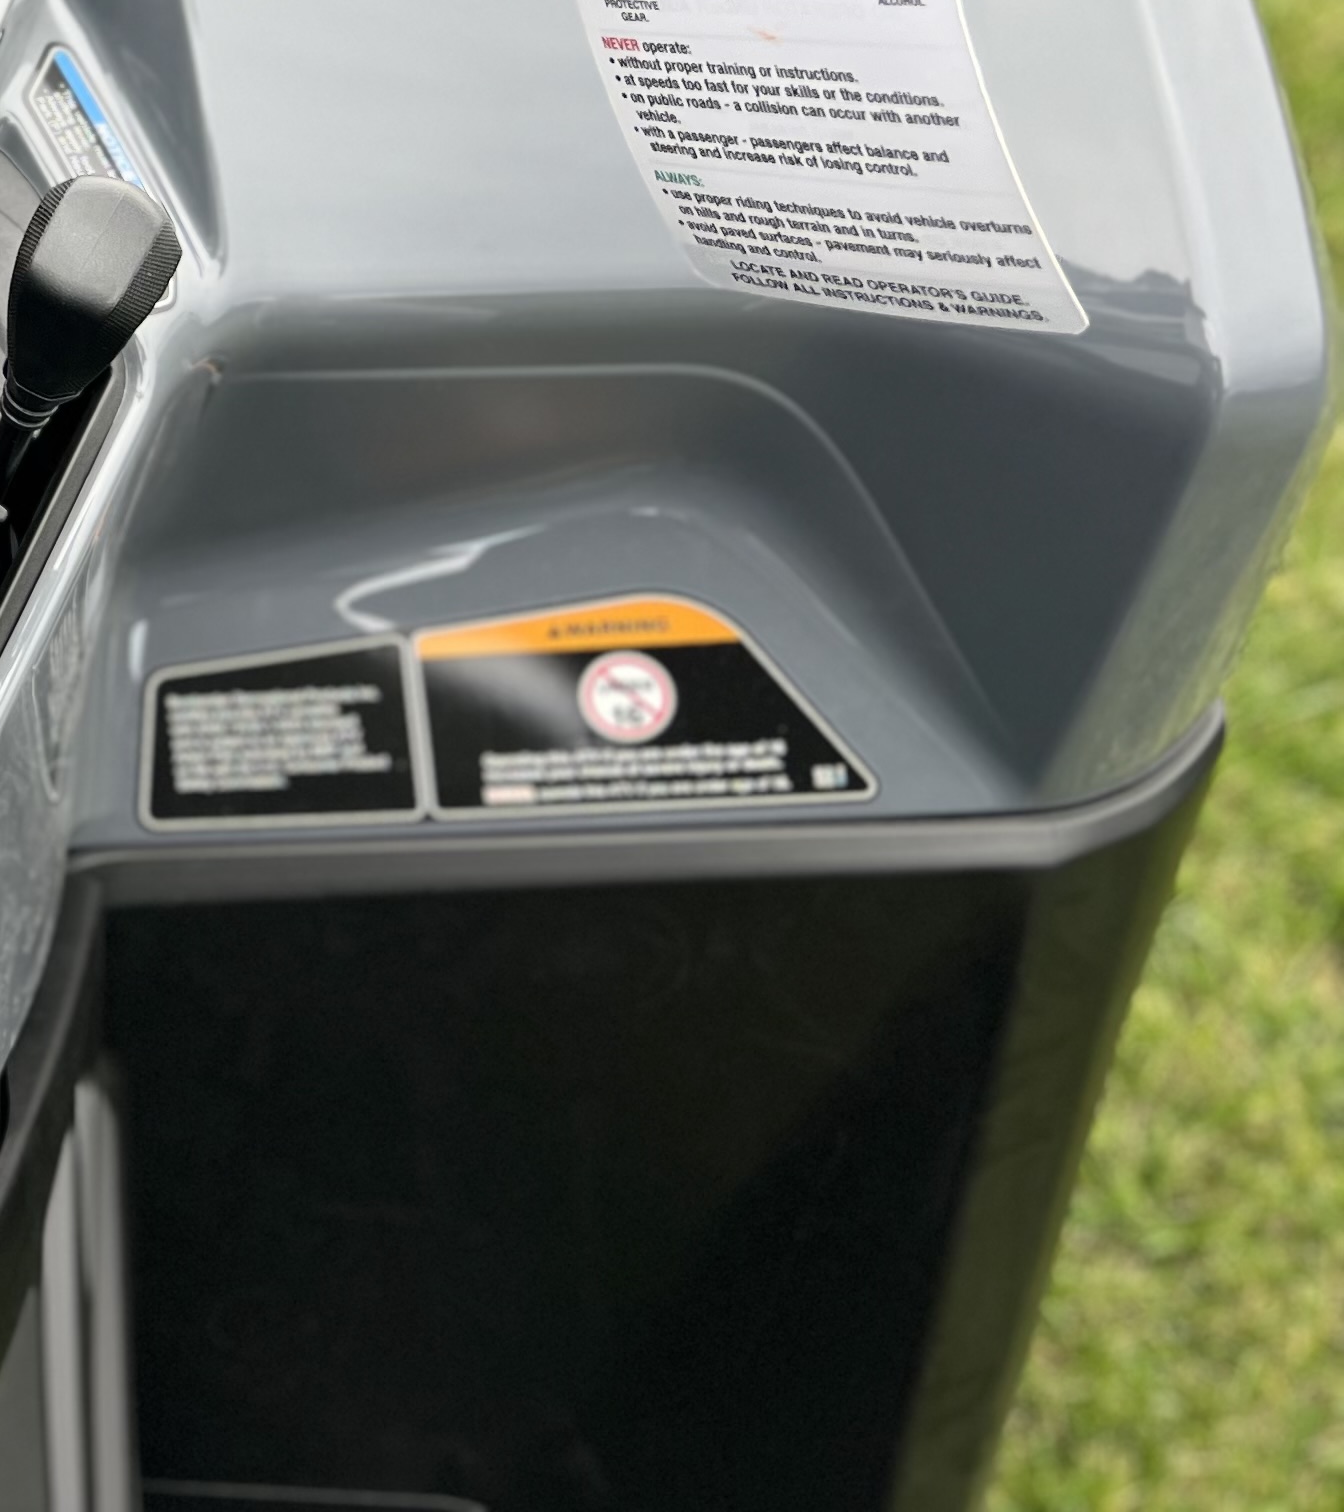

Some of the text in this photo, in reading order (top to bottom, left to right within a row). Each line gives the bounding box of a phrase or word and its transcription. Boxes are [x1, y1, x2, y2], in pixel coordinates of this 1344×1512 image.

[605, 0, 659, 10] PROTECTIVE
[602, 37, 692, 54] NEVER operate:
[618, 56, 859, 83] without proper training or instructions.
[624, 75, 944, 107] at speeds too fast for your skills or the conditions.
[630, 93, 645, 103] on
[647, 94, 684, 107] public
[687, 97, 721, 110] roads
[734, 102, 742, 111] a
[745, 101, 798, 116] collision
[801, 106, 826, 117] can
[830, 108, 866, 121] occur
[870, 109, 901, 123] with
[906, 113, 959, 126] another
[636, 110, 681, 124] vehicle.
[641, 126, 665, 139] with
[668, 130, 675, 139] a
[678, 130, 739, 148] passenger
[749, 136, 823, 153] passengers
[826, 141, 862, 155] affect
[865, 144, 919, 161] balance
[922, 150, 949, 163] and
[650, 141, 697, 159] steering
[700, 147, 722, 159] and
[724, 149, 776, 164] increase
[779, 153, 802, 166] risk
[806, 155, 818, 167] of
[821, 157, 862, 174] losing
[654, 170, 704, 186] ALWAYS:
[670, 189, 1032, 234] use proper riding techniques to avoid vehicle overturns
[679, 205, 694, 215] on
[694, 207, 721, 220] hills
[723, 211, 746, 223] and
[749, 215, 785, 229] rough
[786, 217, 830, 233] terrain
[834, 223, 859, 236] and
[863, 225, 875, 238] in
[687, 220, 718, 234] avoid
[720, 226, 756, 239] paved
[759, 231, 812, 246] surfaces
[825, 239, 891, 256] pavement
[893, 247, 923, 261] may
[926, 249, 992, 267] seriously
[996, 254, 1042, 269] affect
[694, 234, 747, 254] handling
[747, 245, 771, 256] and
[730, 260, 786, 278] LOCATE
[790, 269, 819, 282] AND
[821, 273, 863, 288] READ
[731, 273, 788, 290] FOLLOW
[793, 283, 820, 295] ALL
[824, 287, 934, 310] INSTRUCTIONS
